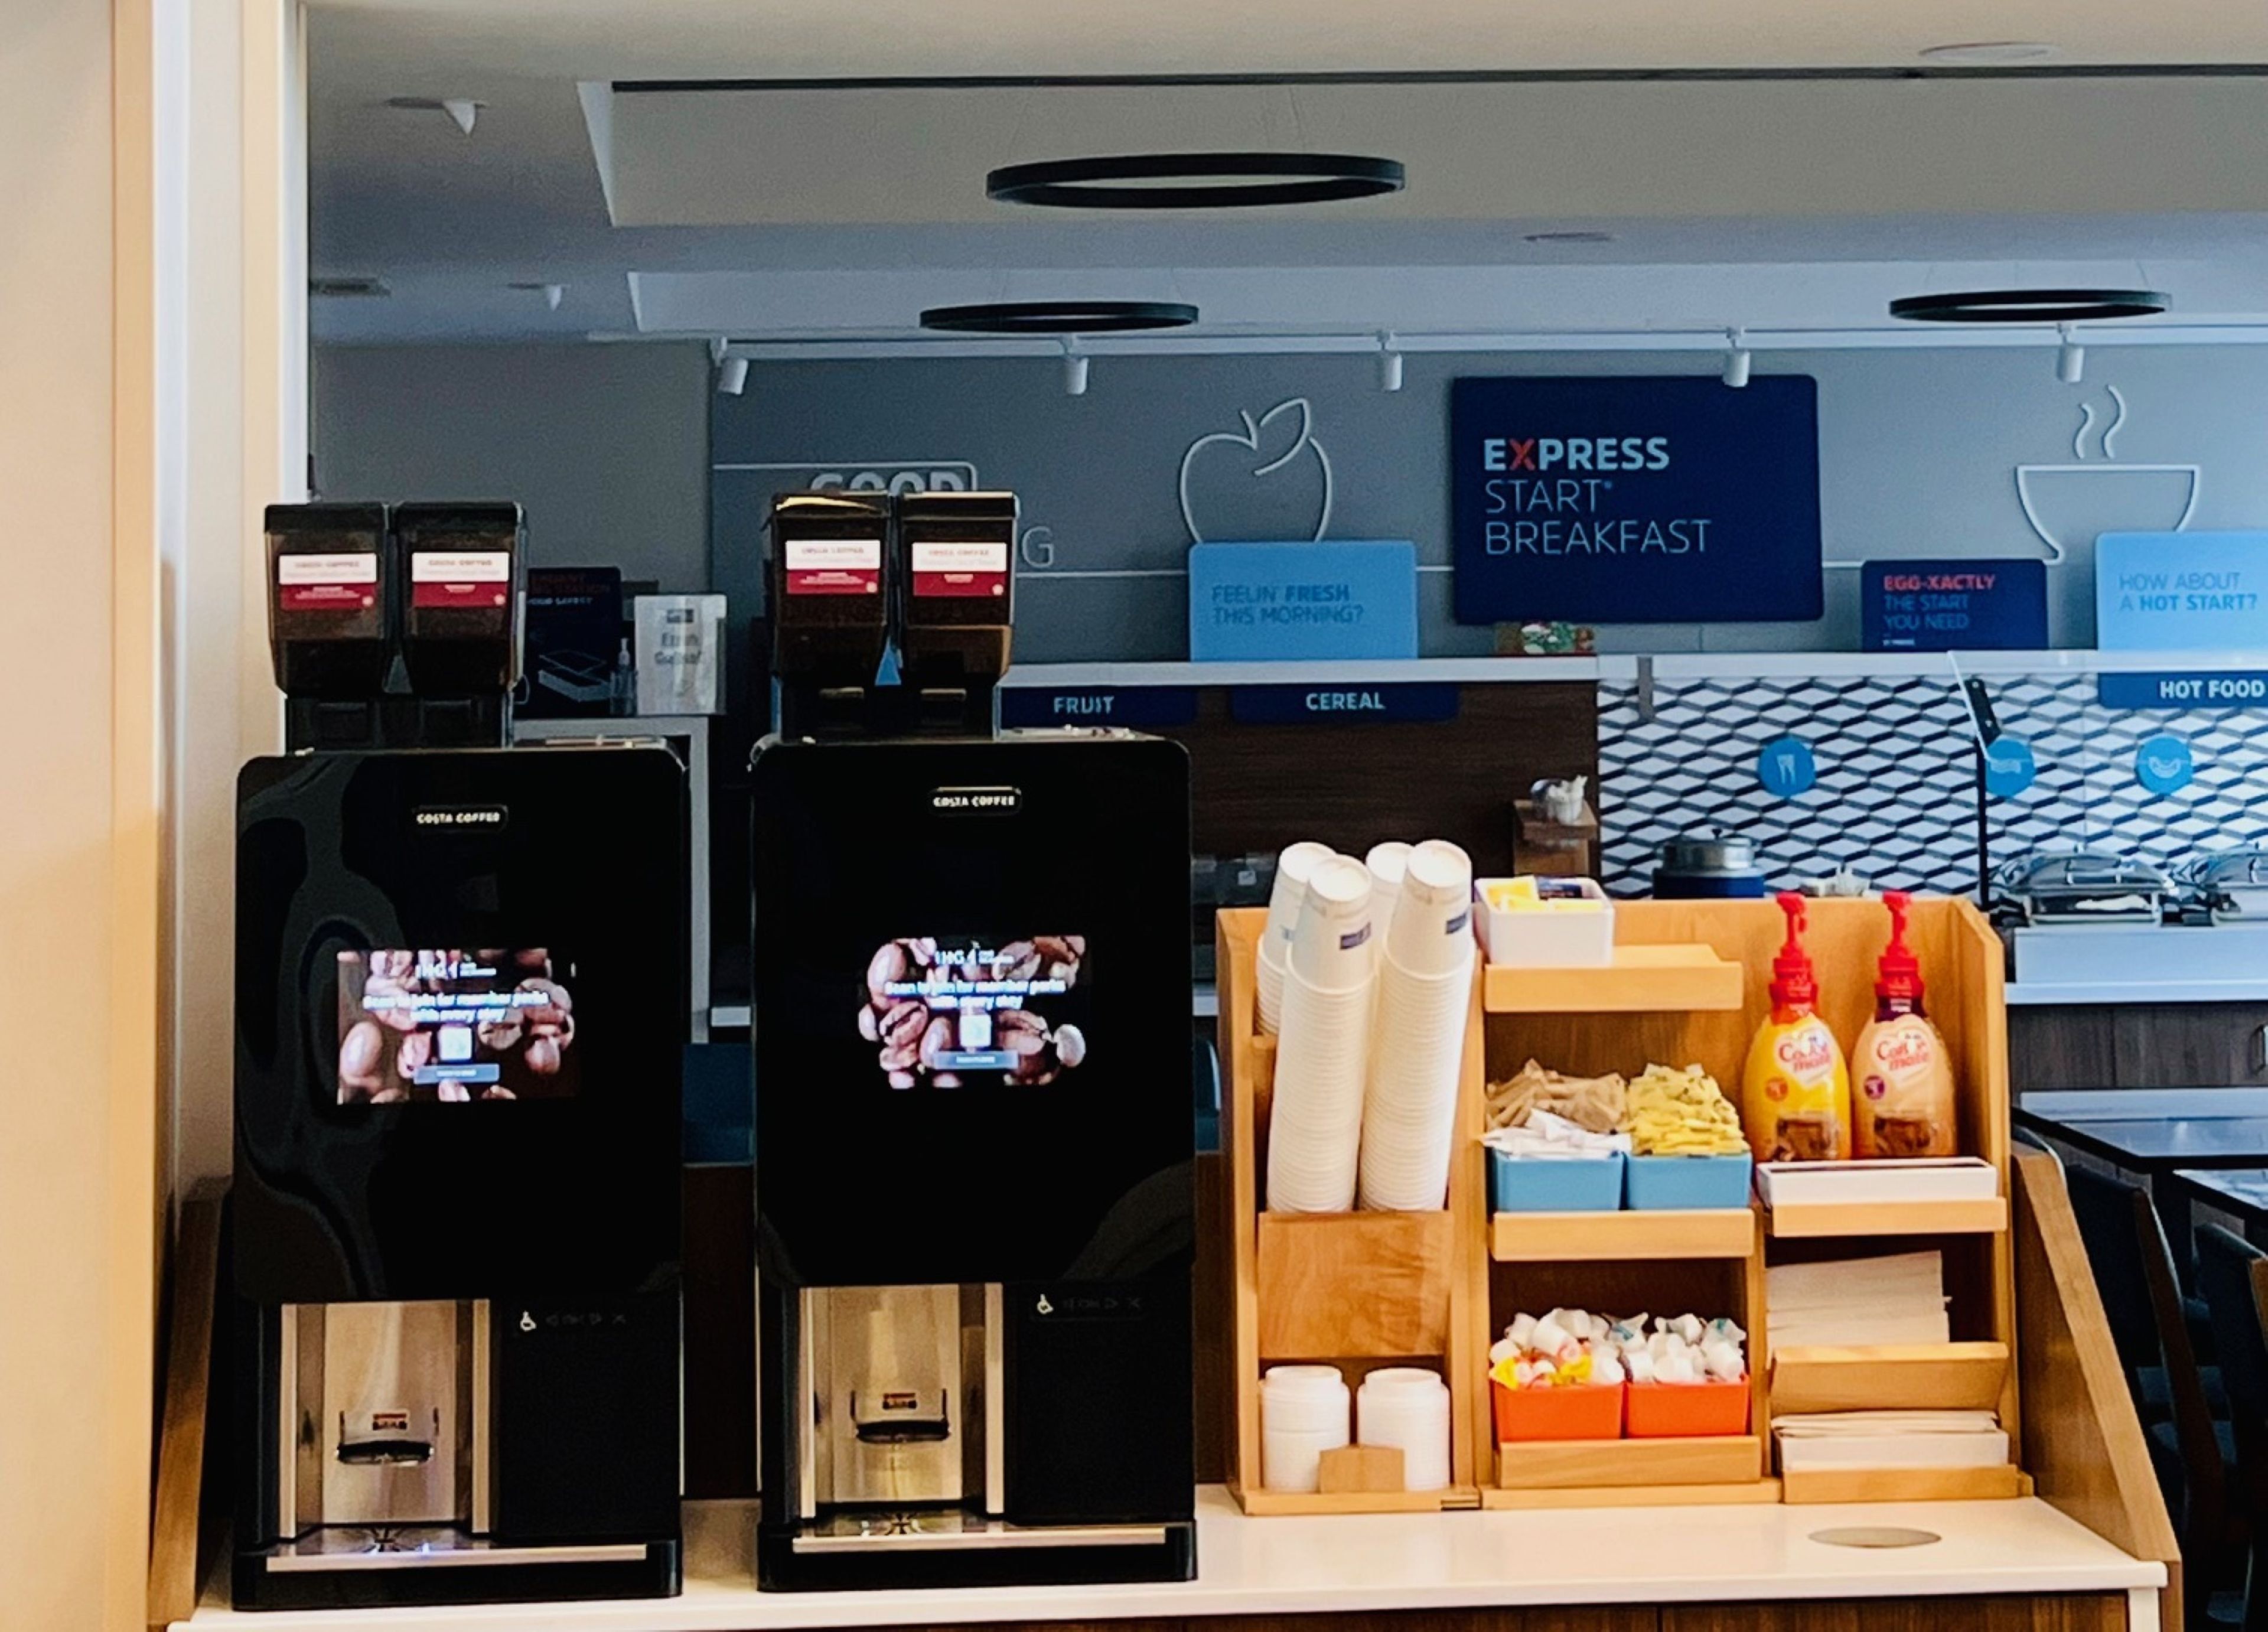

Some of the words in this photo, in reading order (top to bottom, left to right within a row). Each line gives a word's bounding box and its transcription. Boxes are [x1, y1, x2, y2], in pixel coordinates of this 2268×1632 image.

[1484, 438, 1670, 471] EXPRESS
[1485, 519, 1712, 555] BREAKFAST
[2119, 573, 2168, 591] HOW
[2175, 572, 2241, 590] ABOUT
[1285, 584, 1350, 602] FRESH
[1884, 594, 1915, 611] THE
[1920, 593, 1969, 611] START
[2119, 594, 2135, 611] A
[2139, 594, 2179, 611] HOT
[2186, 593, 2258, 611] START?
[1213, 605, 1254, 624] THIS
[1259, 604, 1364, 624] MORNING?
[1883, 614, 1920, 630] YOU
[1924, 613, 1970, 630] NEED
[2159, 680, 2204, 699] HOT
[2208, 679, 2266, 699] FOOD
[1054, 695, 1115, 714] FRUIT
[1305, 692, 1386, 710] CEREAL
[933, 796, 969, 807] COSTA
[416, 812, 453, 825] COSTA
